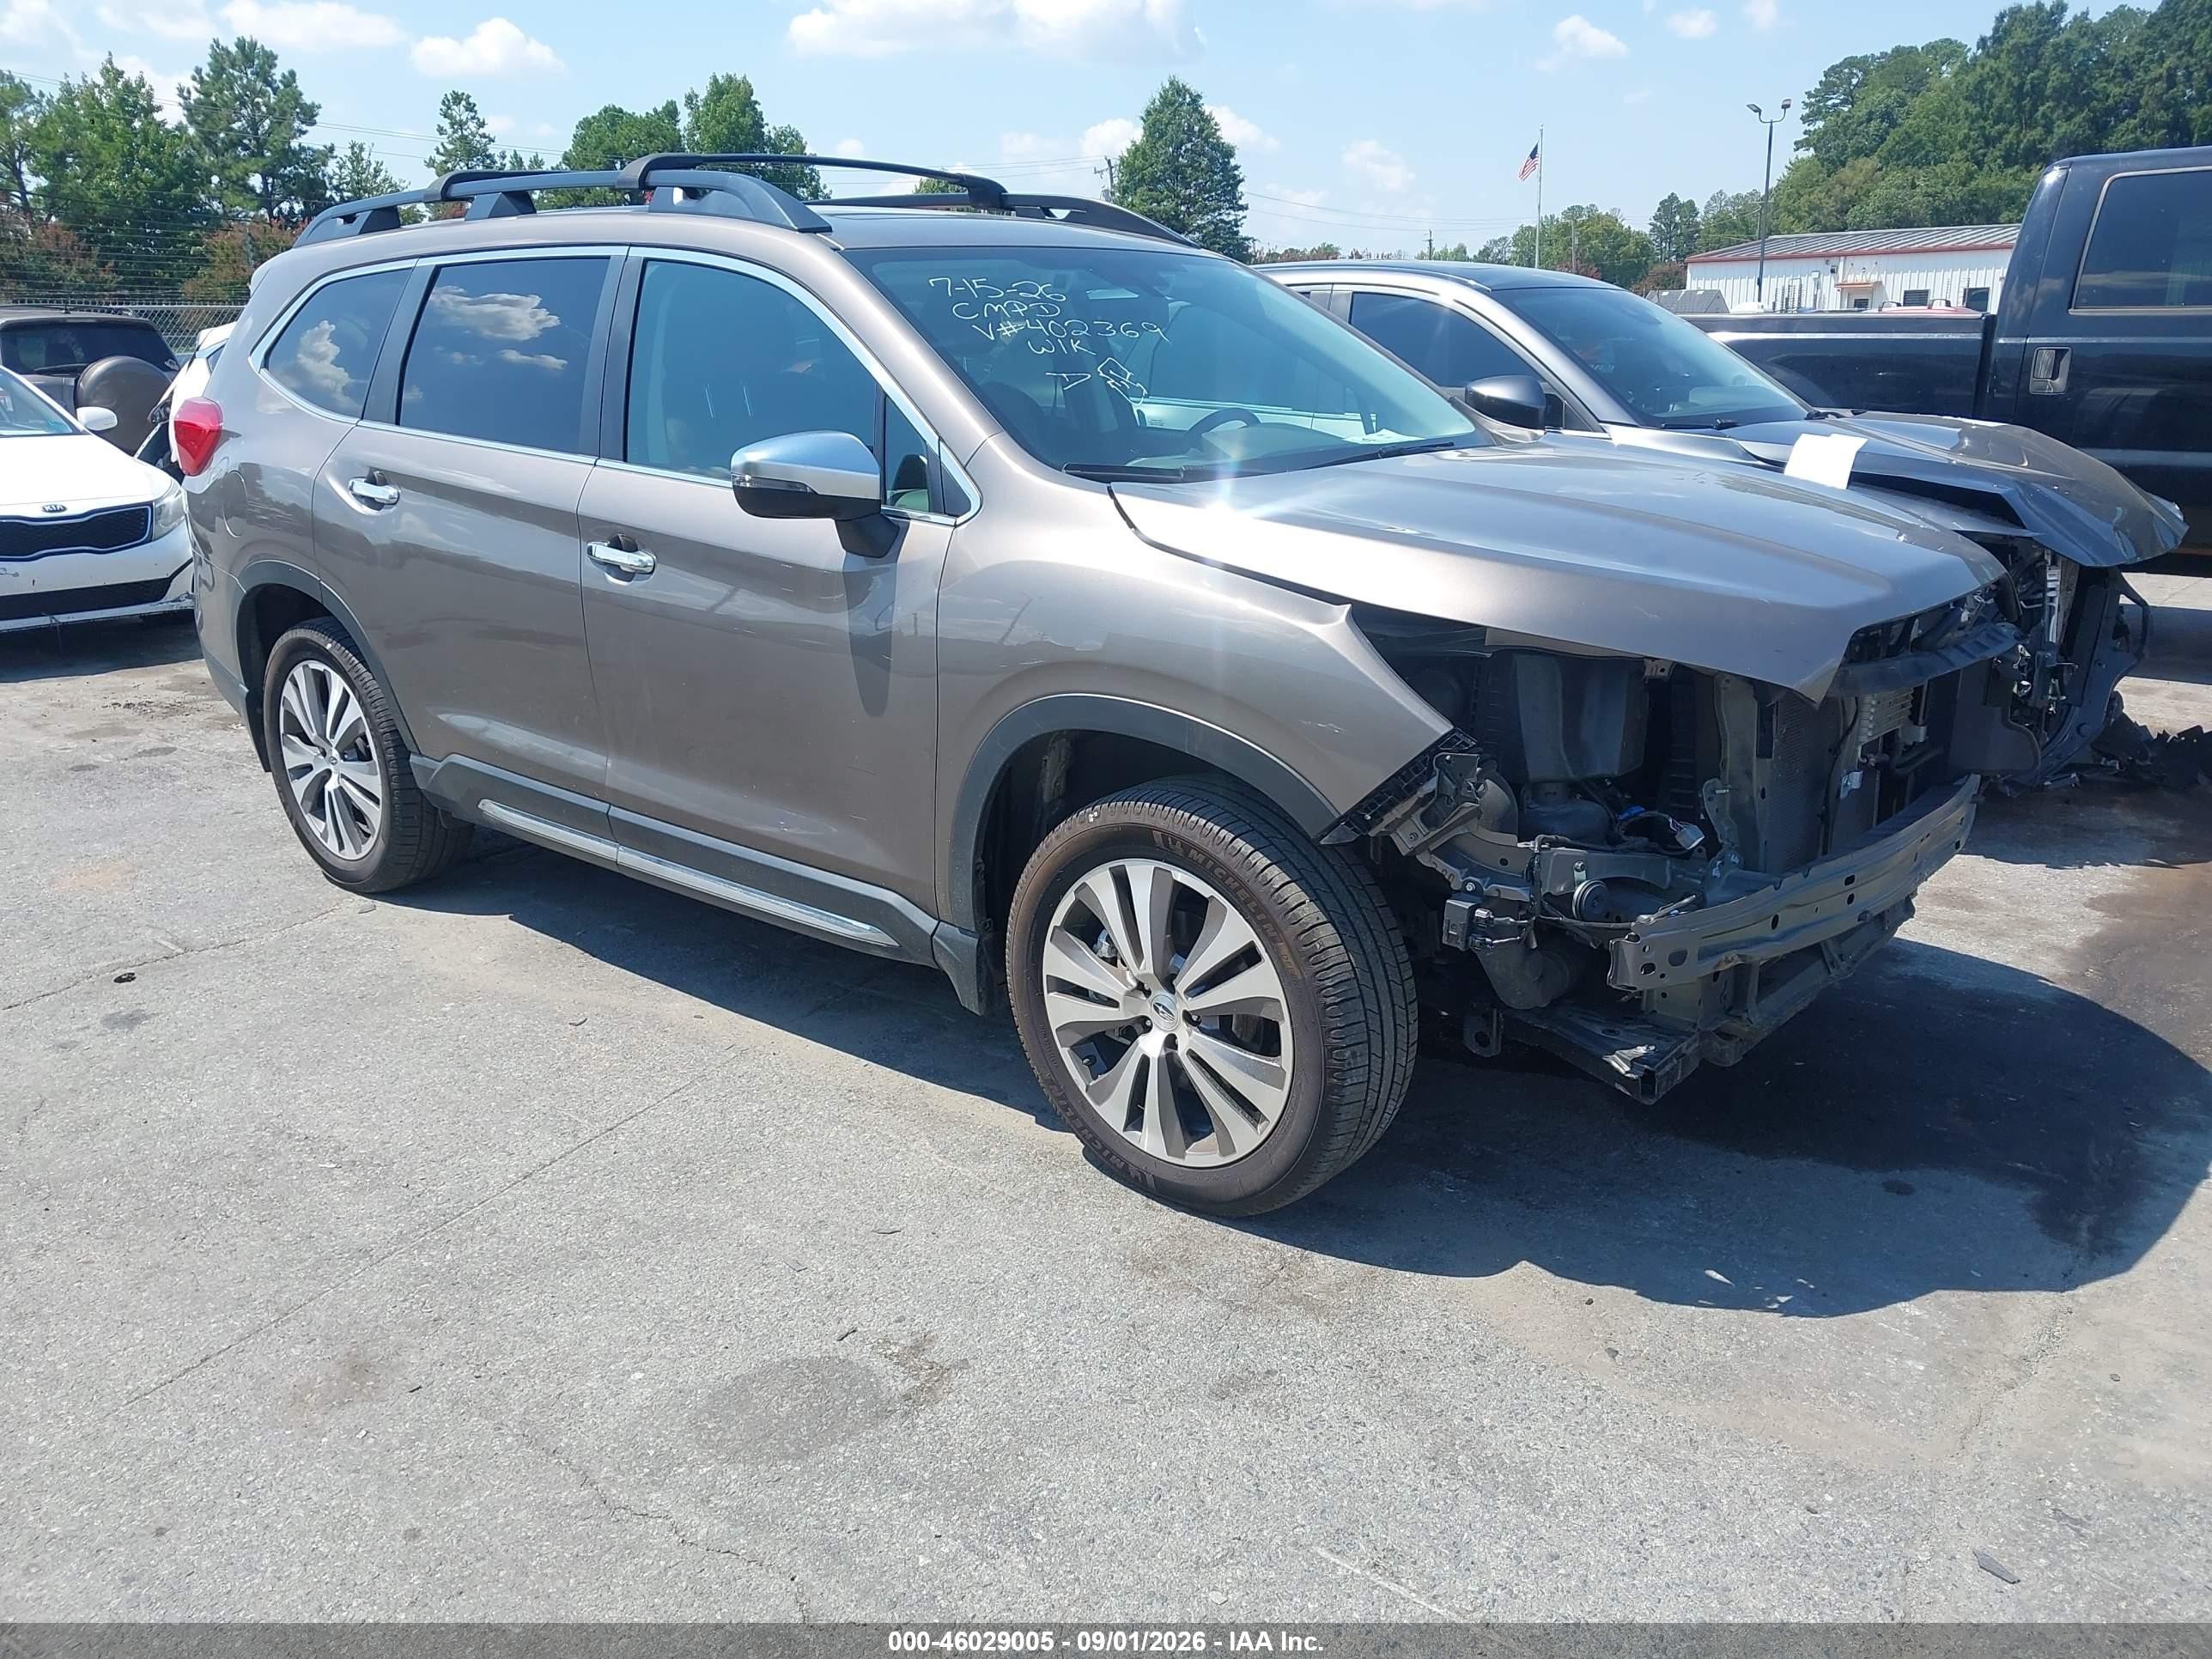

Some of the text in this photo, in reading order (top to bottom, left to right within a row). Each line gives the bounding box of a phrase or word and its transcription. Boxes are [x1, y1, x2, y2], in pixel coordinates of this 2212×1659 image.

[928, 276, 1066, 301] 7-15-26
[951, 300, 1061, 319] CMPD
[43, 503, 67, 514] KIA
[1187, 846, 1283, 943] MICHELIN
